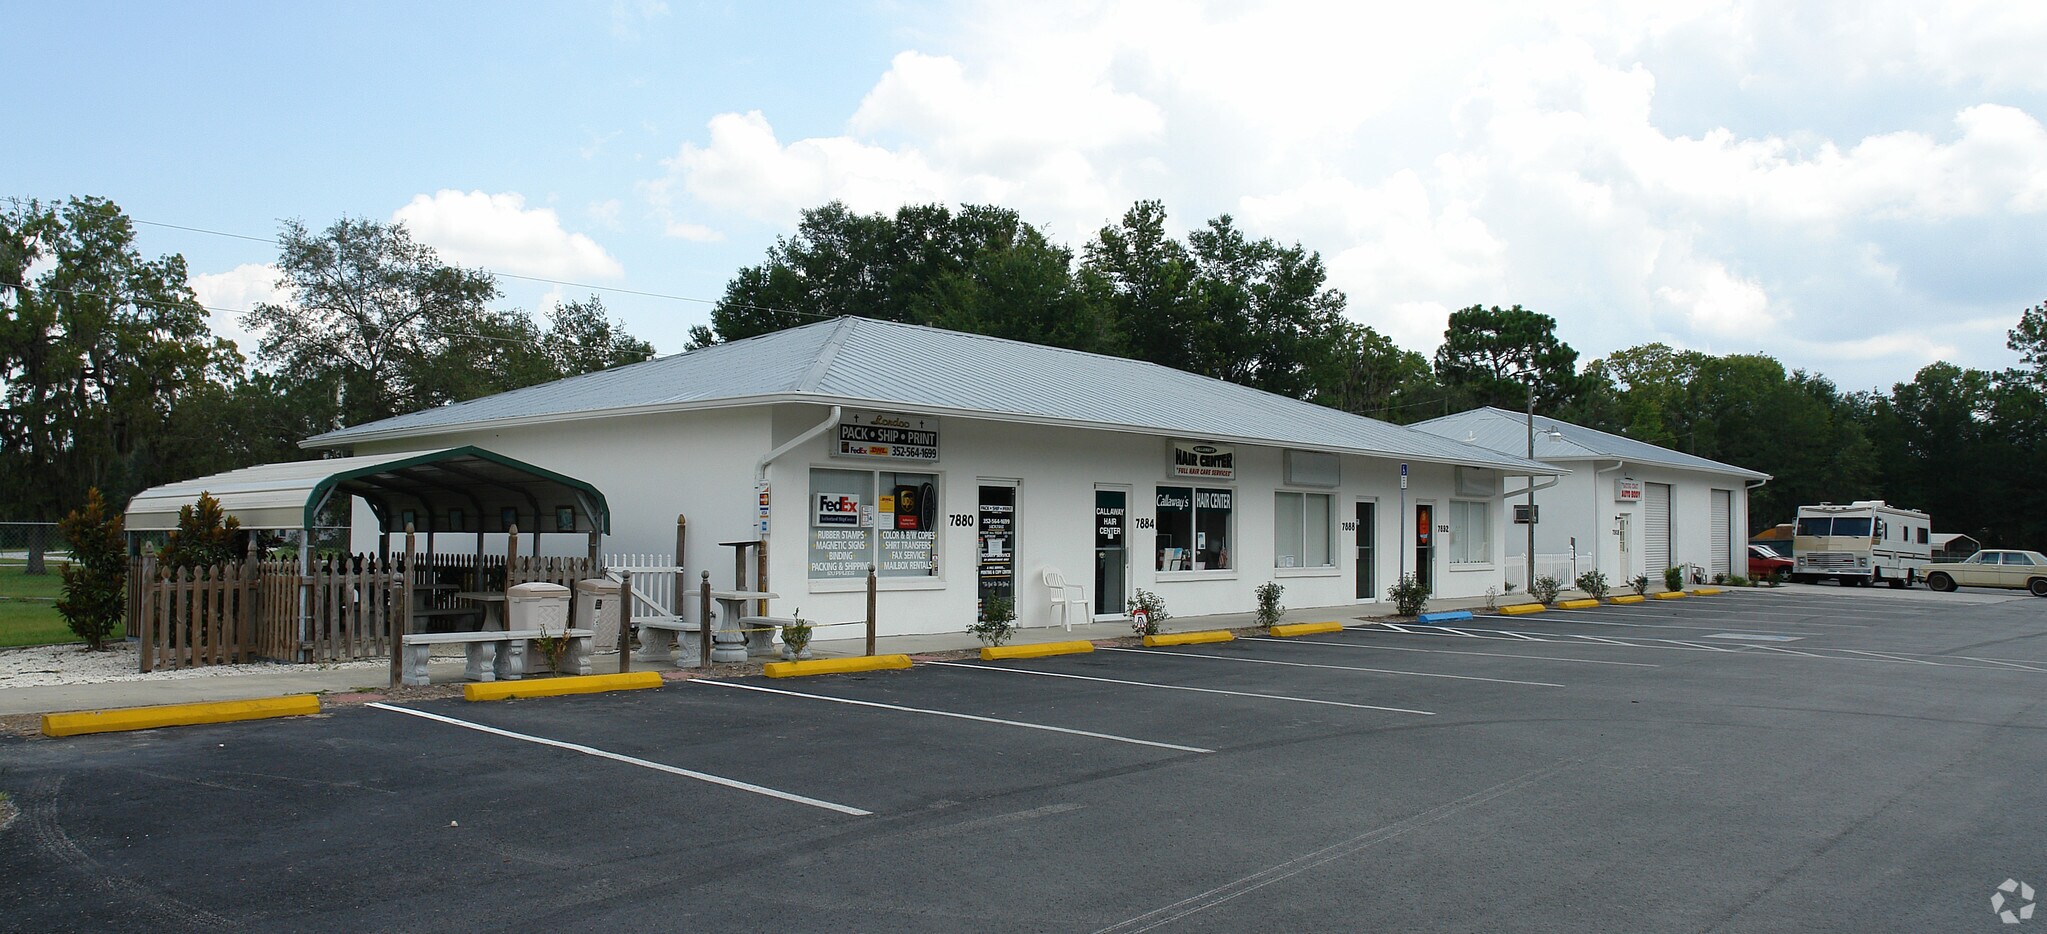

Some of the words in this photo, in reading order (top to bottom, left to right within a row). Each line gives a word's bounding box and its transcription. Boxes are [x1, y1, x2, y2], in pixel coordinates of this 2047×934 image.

[842, 426, 869, 440] PACK
[878, 428, 899, 442] SHIP
[908, 431, 935, 446] PRINT
[892, 446, 937, 459] 352-564-1699
[1175, 447, 1198, 466] HAIR
[1200, 452, 1233, 469] CENTER
[820, 495, 858, 513] FedEx
[1156, 494, 1189, 510] Callaway's
[1196, 492, 1210, 508] HAIR
[1210, 493, 1231, 509] CENTER
[1096, 507, 1124, 515] CALLAWAY
[949, 514, 974, 527] 7880
[1103, 517, 1117, 526] HAIR
[1135, 518, 1154, 529] 7884
[1099, 527, 1121, 535] CENTER
[1341, 522, 1355, 531] 7888
[817, 530, 841, 539] RUBBER
[841, 530, 865, 540] STAMPS
[882, 531, 900, 540] COLOR
[900, 531, 905, 540] &
[917, 531, 935, 540] COPIES
[816, 541, 847, 549] MAGNETIC
[848, 541, 865, 550] SIGNS
[885, 541, 902, 549] SHIRT
[902, 541, 931, 550] TRANSFERS
[828, 551, 853, 560] BINDING
[891, 551, 903, 559] FAX
[903, 551, 926, 560] SERVICE
[811, 562, 837, 571] PACKING
[839, 562, 845, 571] &
[845, 562, 870, 571] SHIPPING
[883, 561, 909, 570] MAILBOX
[909, 561, 933, 570] RENTALS
